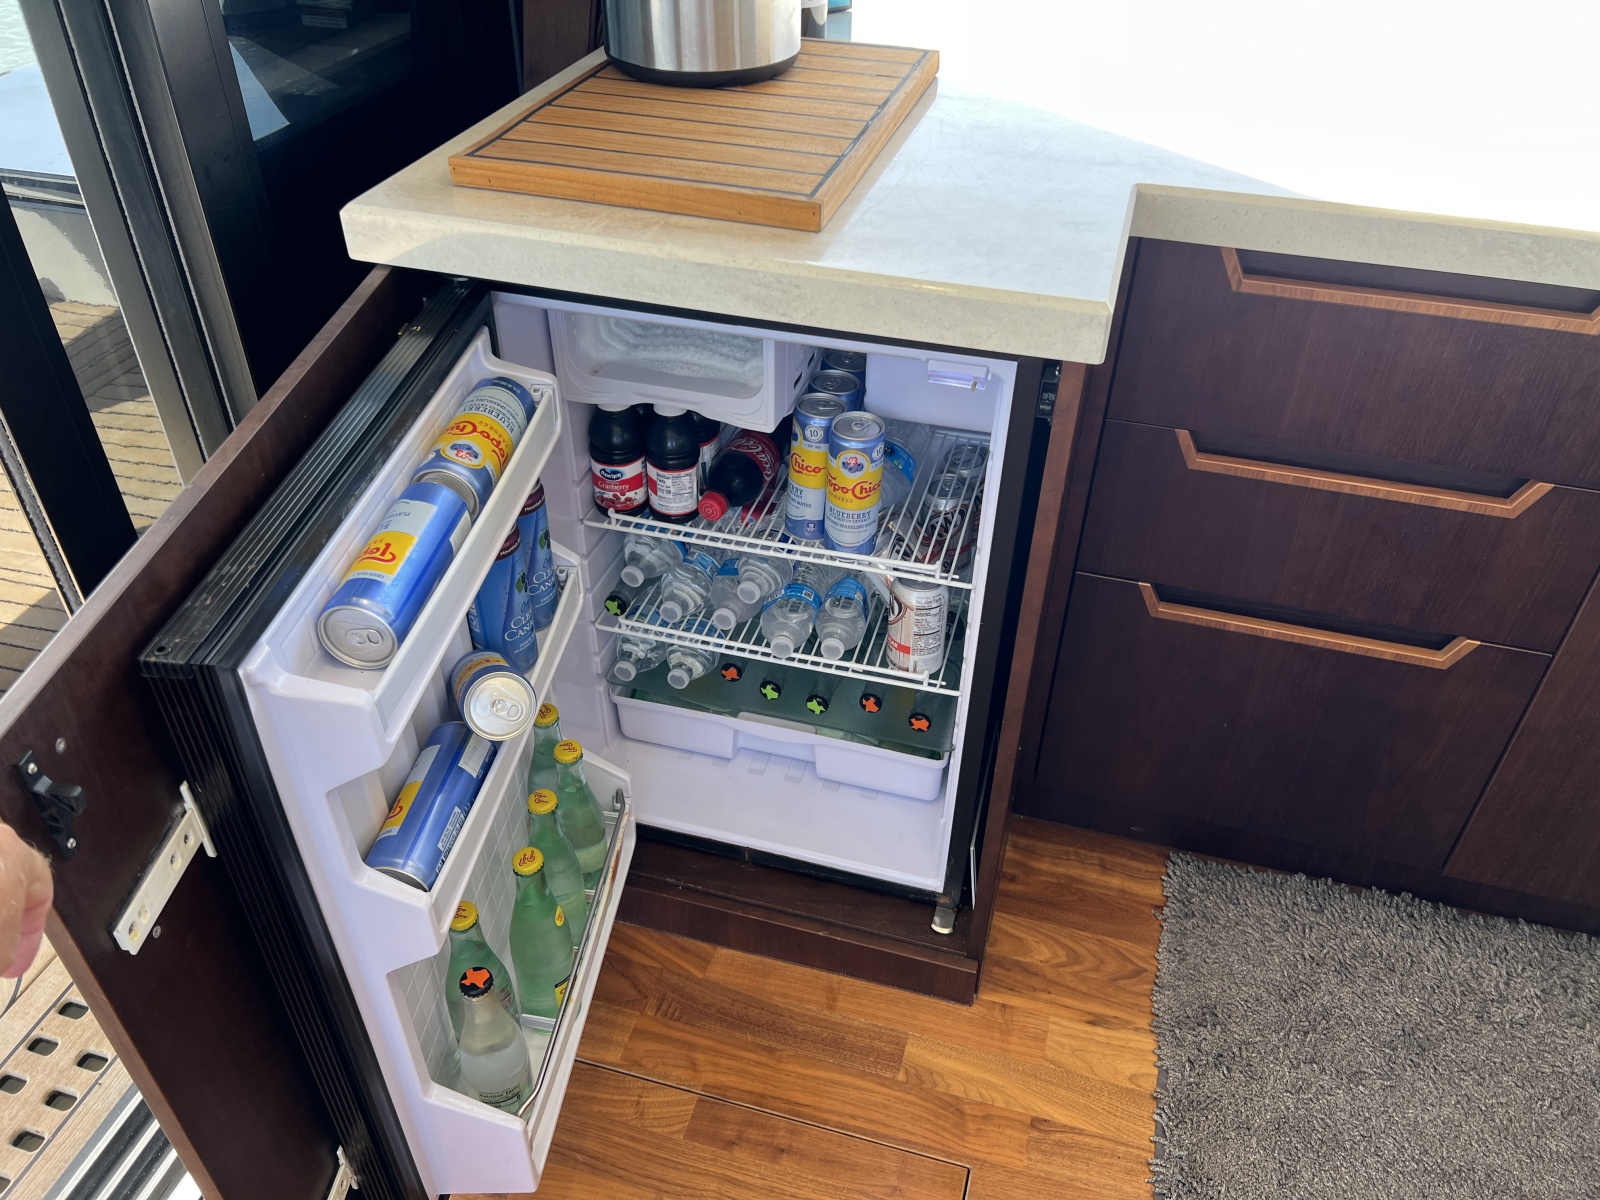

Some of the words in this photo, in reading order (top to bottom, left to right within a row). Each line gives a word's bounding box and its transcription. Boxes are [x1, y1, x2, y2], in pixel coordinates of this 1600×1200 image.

[479, 420, 509, 448] SABORES
[809, 429, 818, 438] 10
[790, 452, 826, 475] Chico
[598, 480, 630, 492] Cranberry
[829, 505, 871, 519] BLUEBERRY
